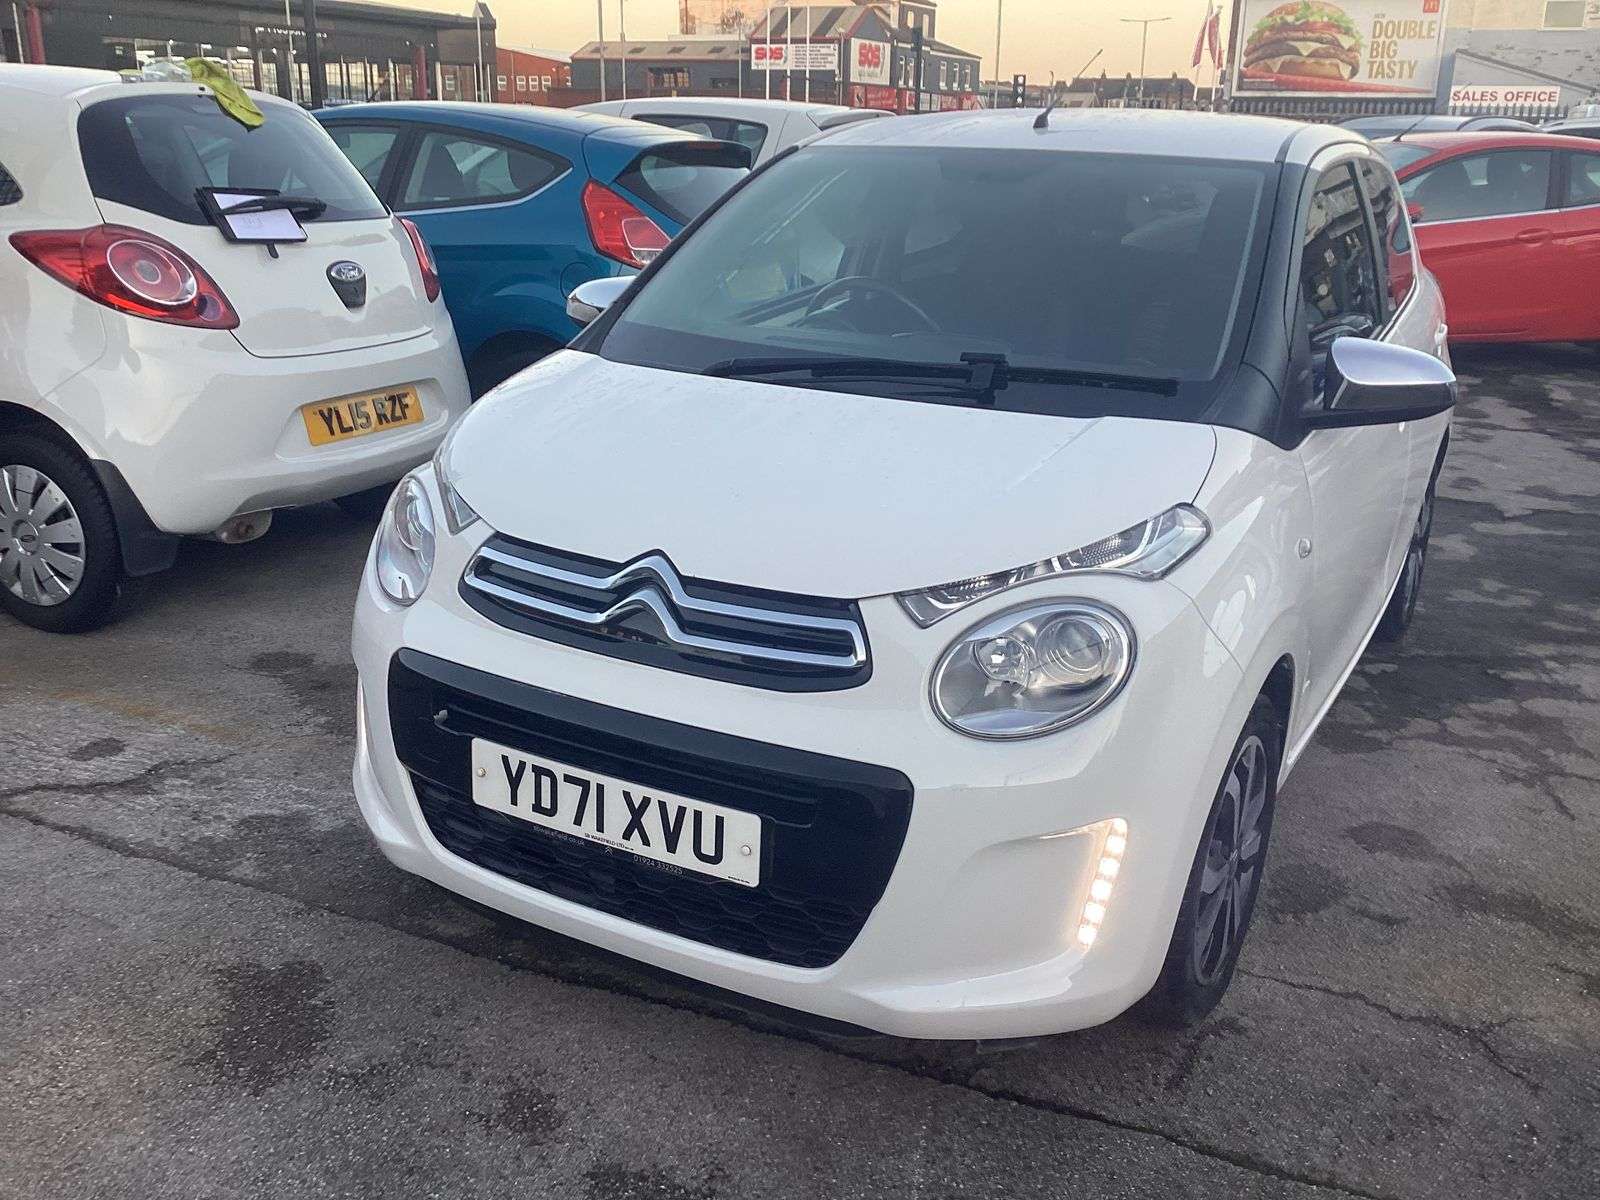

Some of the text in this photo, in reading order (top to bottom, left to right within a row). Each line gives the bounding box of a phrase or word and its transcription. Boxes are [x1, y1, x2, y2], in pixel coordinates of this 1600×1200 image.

[1372, 20, 1437, 39] DOUBLE
[1369, 40, 1398, 59] BIG
[1367, 59, 1418, 79] TASTY
[1451, 90, 1557, 102] SALES OFFICE
[318, 391, 410, 436] YL15 RZF
[501, 754, 725, 866] YD71 XVU
[633, 854, 655, 867] 01924
